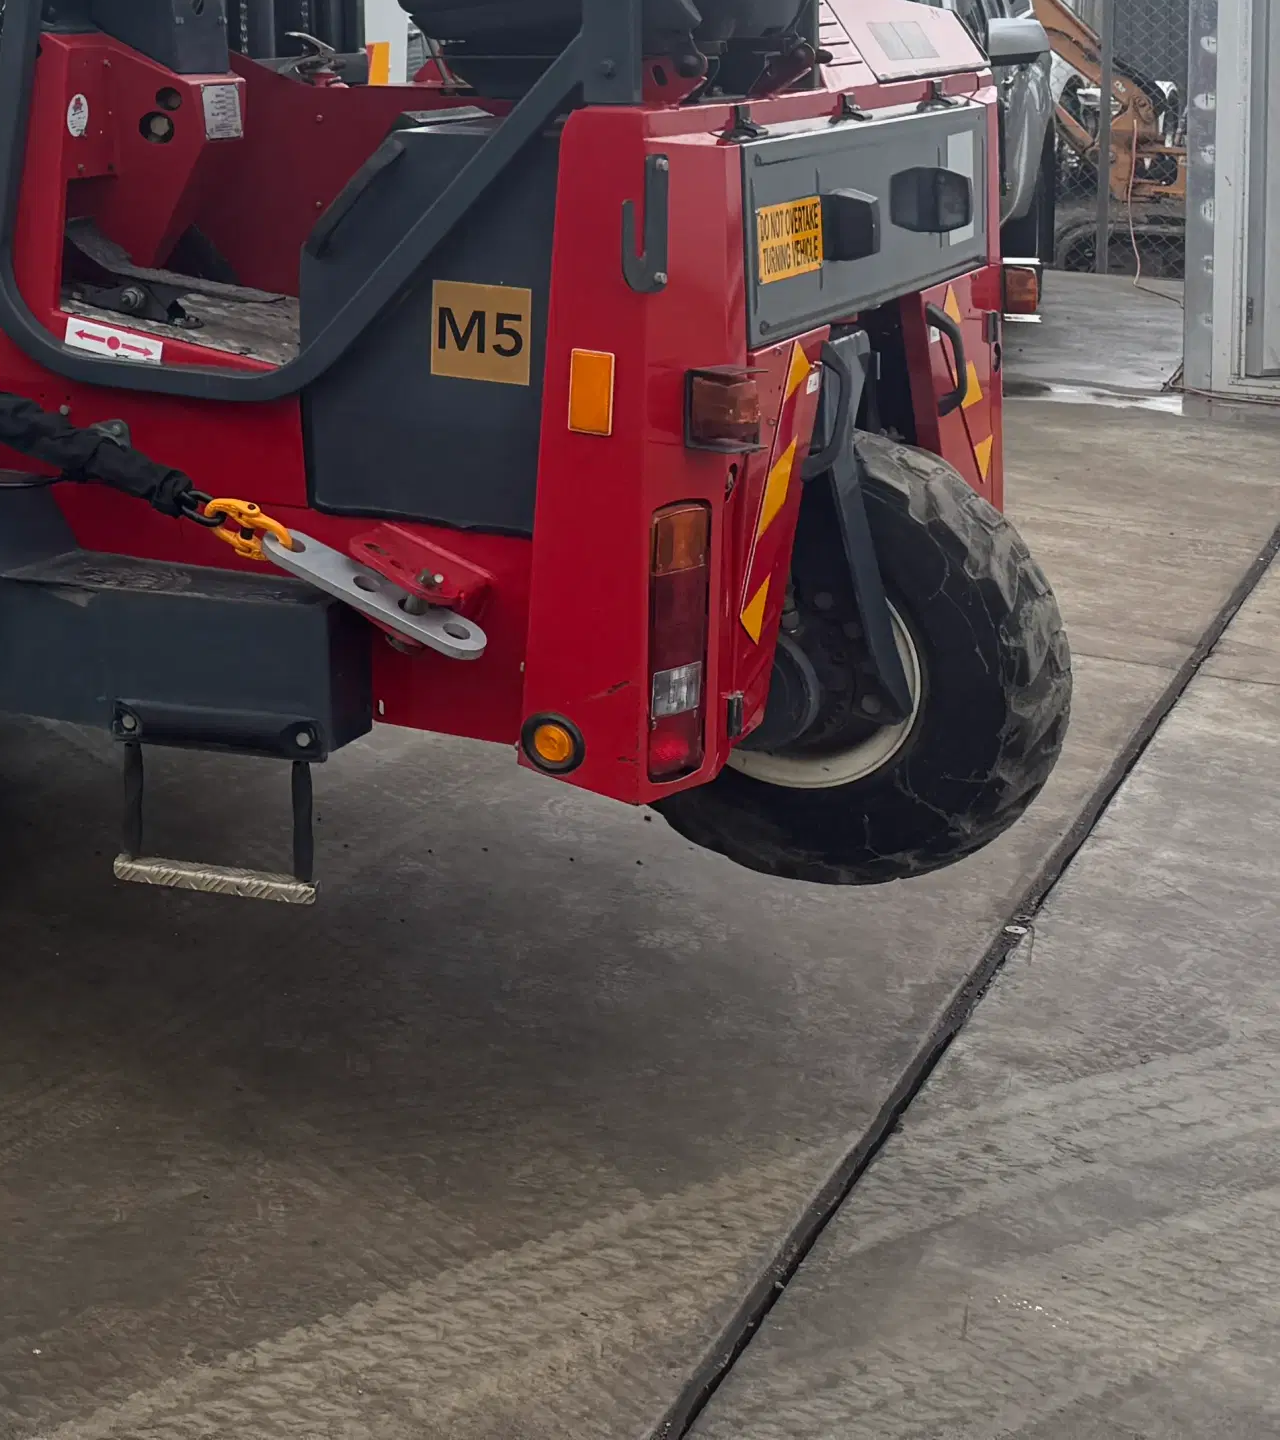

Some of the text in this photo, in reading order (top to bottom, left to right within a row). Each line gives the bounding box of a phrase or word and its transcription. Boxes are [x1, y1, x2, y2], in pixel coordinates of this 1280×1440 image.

[760, 203, 819, 242] DO NOT OVERTAKE
[763, 235, 819, 275] TURNING VEHICLE
[438, 306, 523, 357] M5
